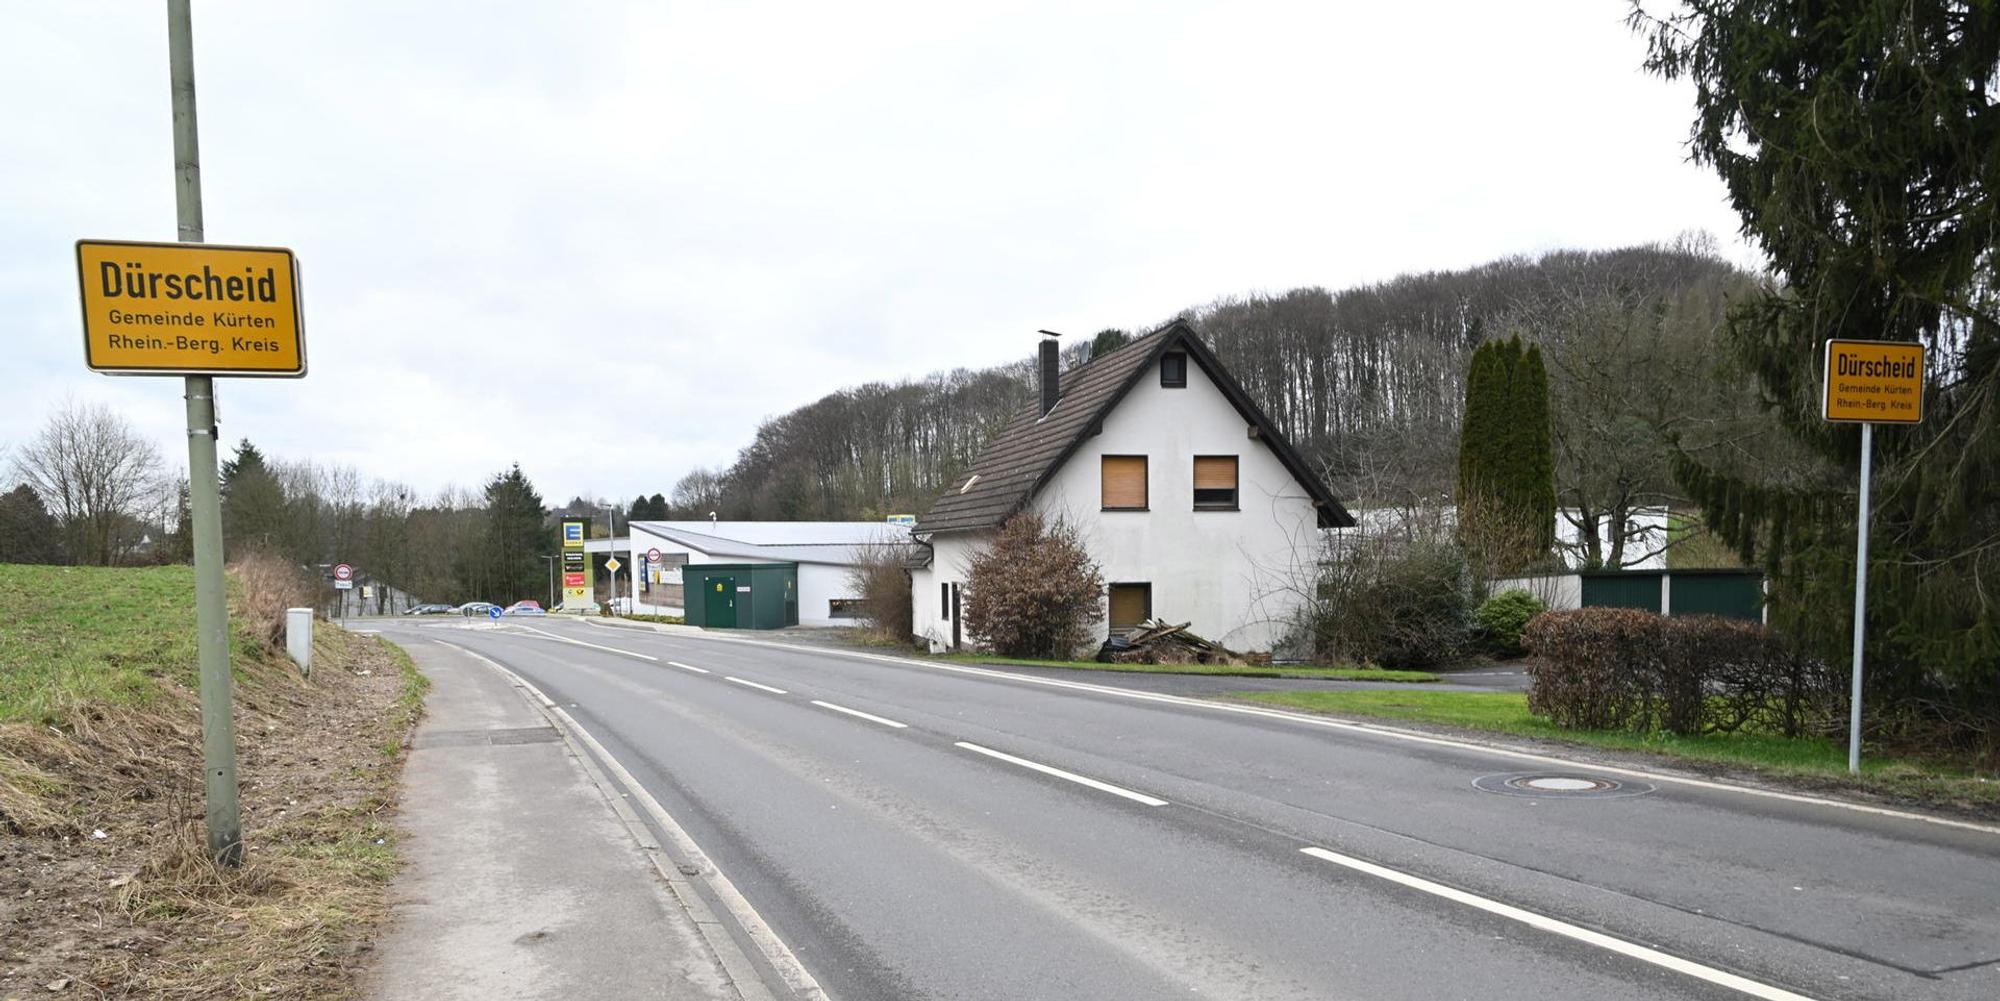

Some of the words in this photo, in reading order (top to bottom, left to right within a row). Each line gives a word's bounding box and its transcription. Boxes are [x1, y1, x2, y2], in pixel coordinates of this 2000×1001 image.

[100, 261, 276, 303] Dürscheid
[109, 309, 205, 327] Gemeinde
[213, 312, 275, 328] Kürten
[108, 334, 224, 354] Rhein.-Berg.
[232, 336, 279, 352] Kreis
[1838, 353, 1915, 378] Dürscheid
[1838, 382, 1881, 394] Gemeinde
[1884, 383, 1913, 395] Kürten
[1891, 399, 1912, 410] Kreis
